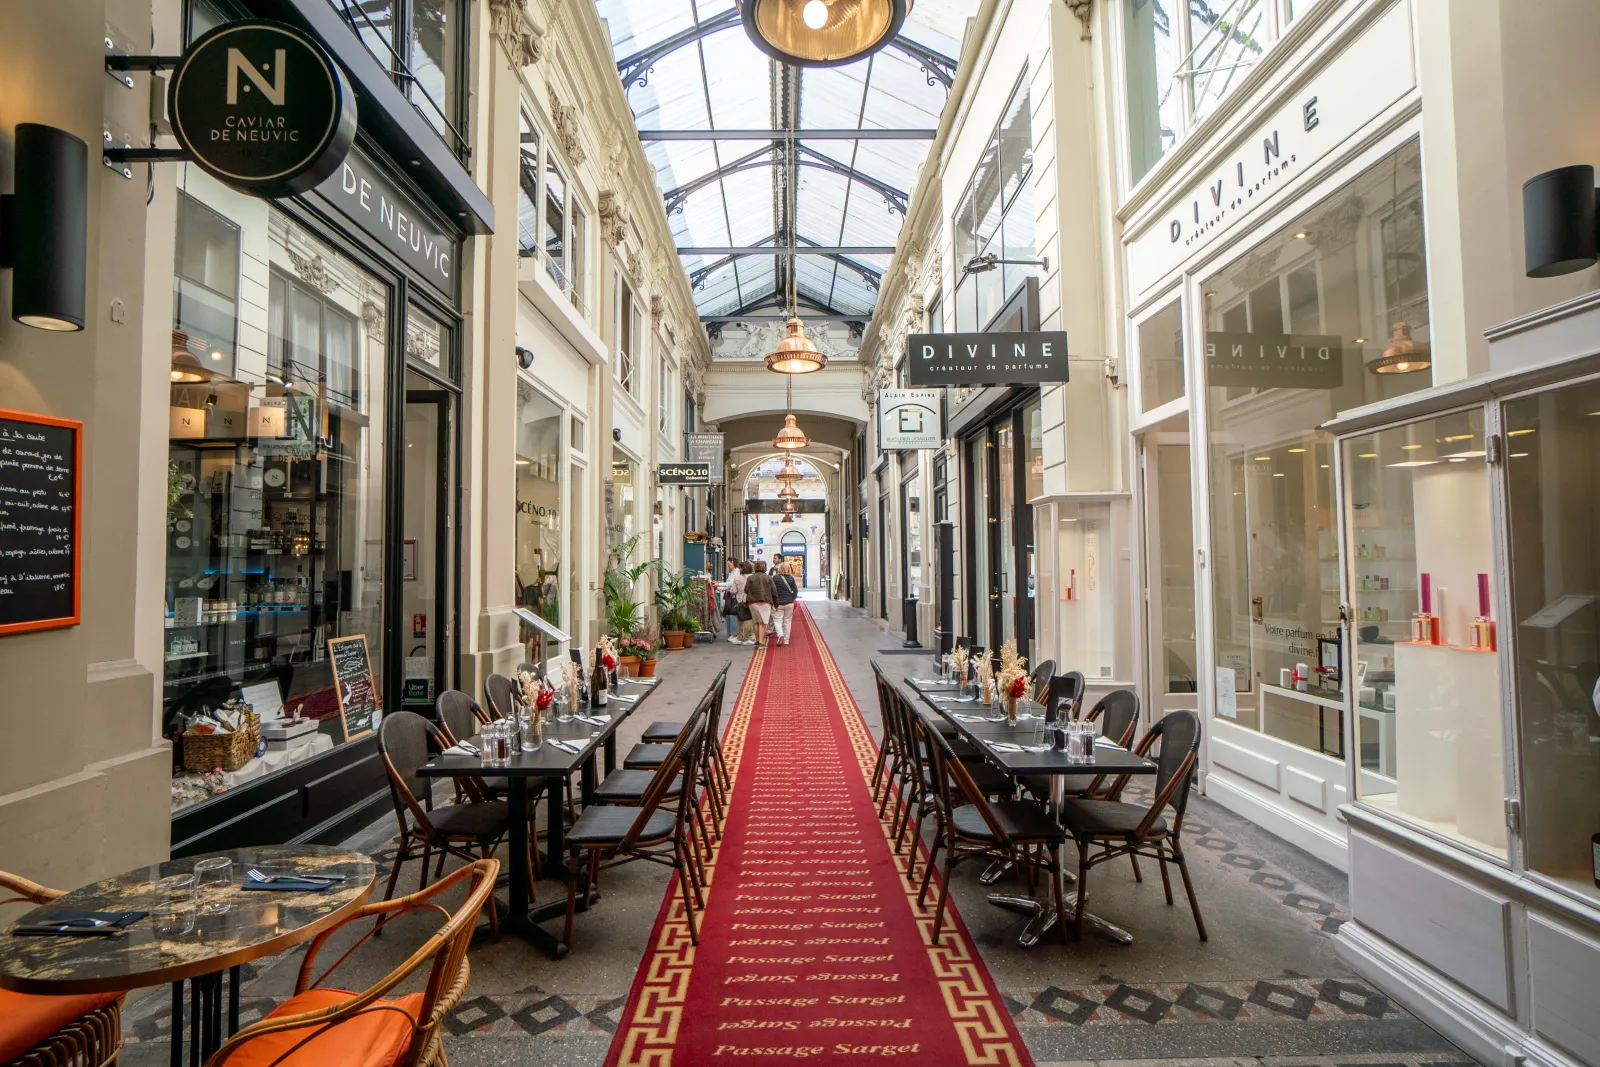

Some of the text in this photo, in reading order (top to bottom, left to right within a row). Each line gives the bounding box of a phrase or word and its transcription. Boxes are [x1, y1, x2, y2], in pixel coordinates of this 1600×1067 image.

[227, 47, 286, 106] N
[225, 116, 285, 128] CAVIAR
[210, 129, 299, 141] DE NEUVIC
[1169, 95, 1320, 244] DIVINE
[1185, 153, 1298, 247] créateur de parfums
[342, 161, 449, 278] DE NEUVIC
[922, 342, 1053, 359] DIVINE
[929, 363, 1049, 372] créateur de parfums
[660, 467, 708, 476] SCÉNO.10
[1264, 623, 1284, 637] Votre
[1285, 627, 1314, 640] parfum
[730, 922, 814, 930] Passage
[725, 954, 894, 964] Passage Sarget
[723, 973, 899, 984] Passage Sarget
[720, 995, 905, 1007] Passage Sarget
[717, 1018, 912, 1030] Passage Sarget
[712, 1043, 920, 1057] Passage Sarget
